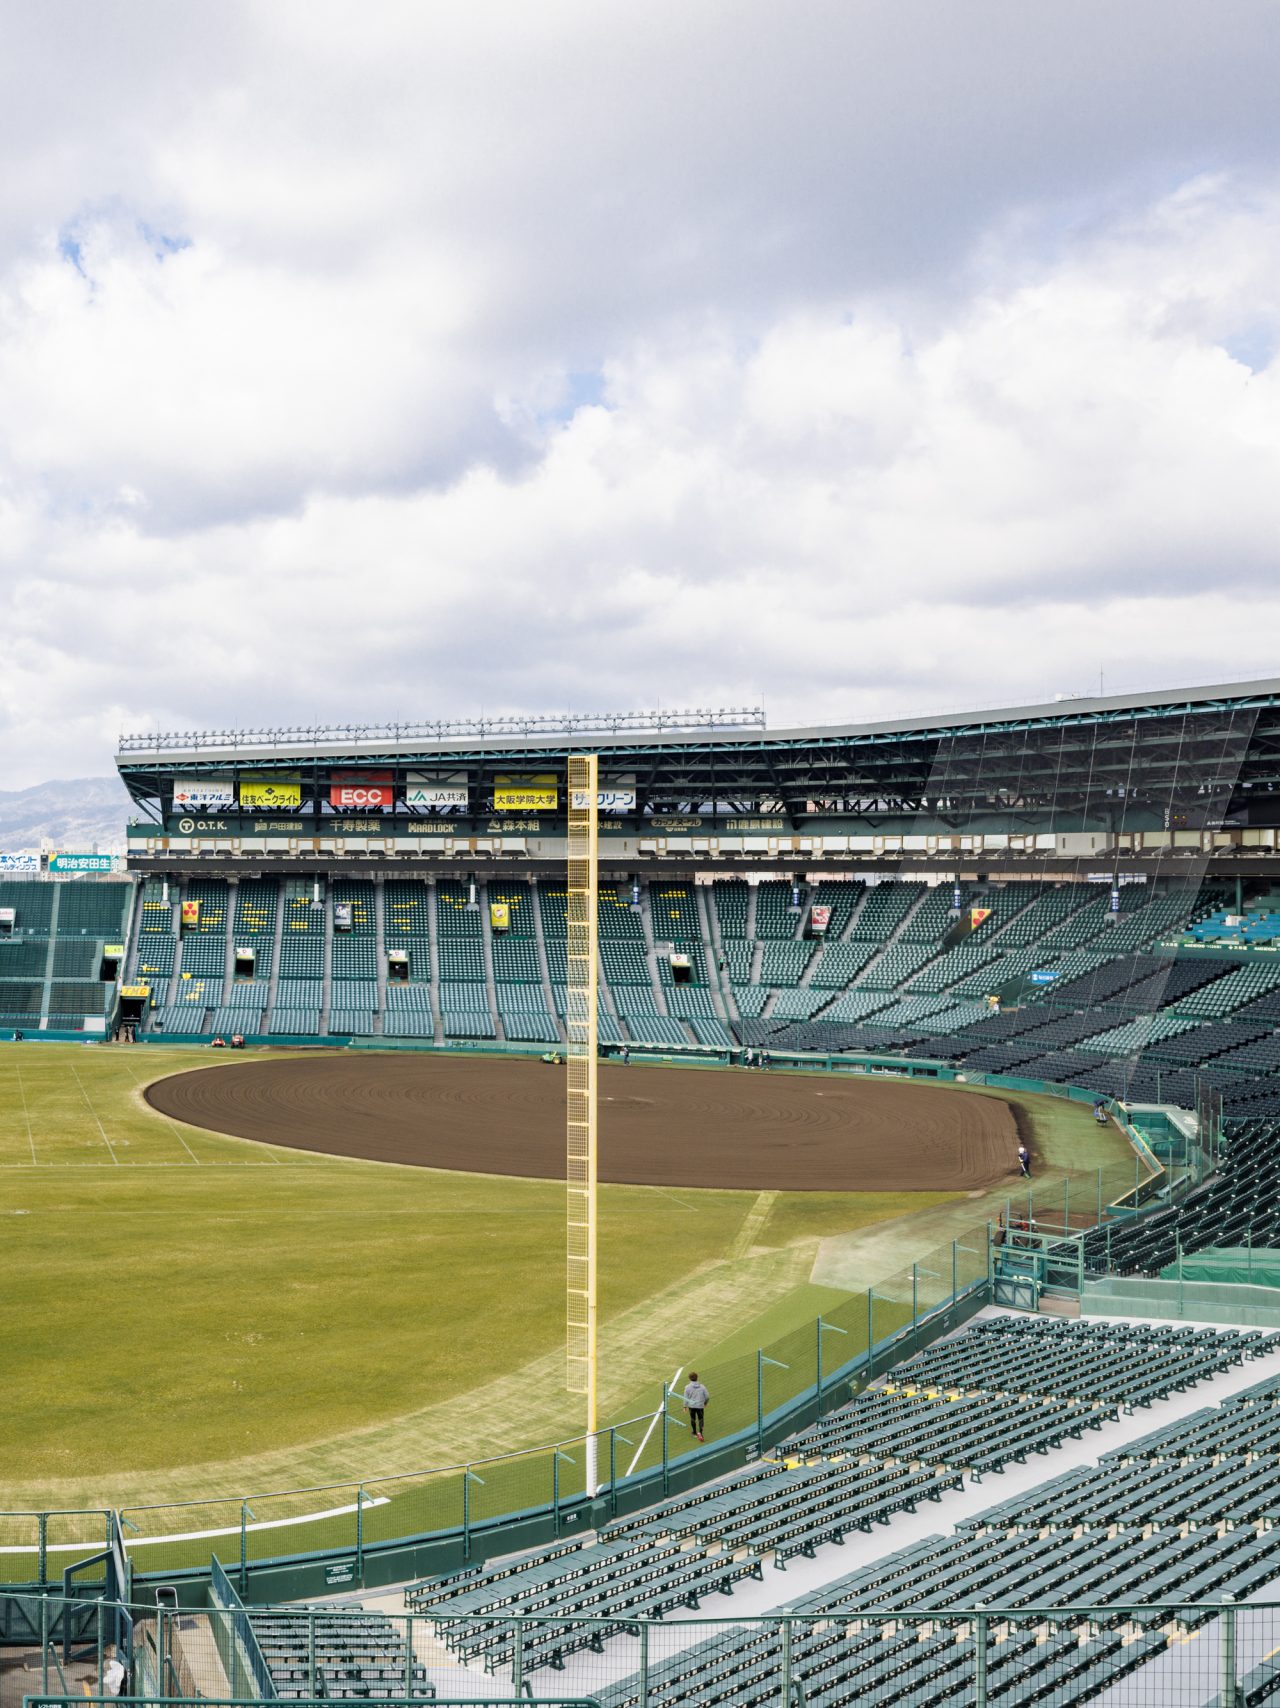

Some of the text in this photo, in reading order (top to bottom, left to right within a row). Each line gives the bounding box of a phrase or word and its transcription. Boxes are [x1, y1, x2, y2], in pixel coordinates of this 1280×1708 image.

[241, 795, 298, 805] 住友ベークライト
[341, 789, 382, 803] ECC
[430, 792, 467, 802] JA共済
[496, 794, 556, 805] 大阪学院大学
[574, 793, 634, 805] サクリーン
[197, 821, 227, 830] O.T.K.
[329, 820, 381, 832] 千寿製薬
[502, 820, 540, 831] 森本組
[57, 857, 121, 869] 明治安田生命
